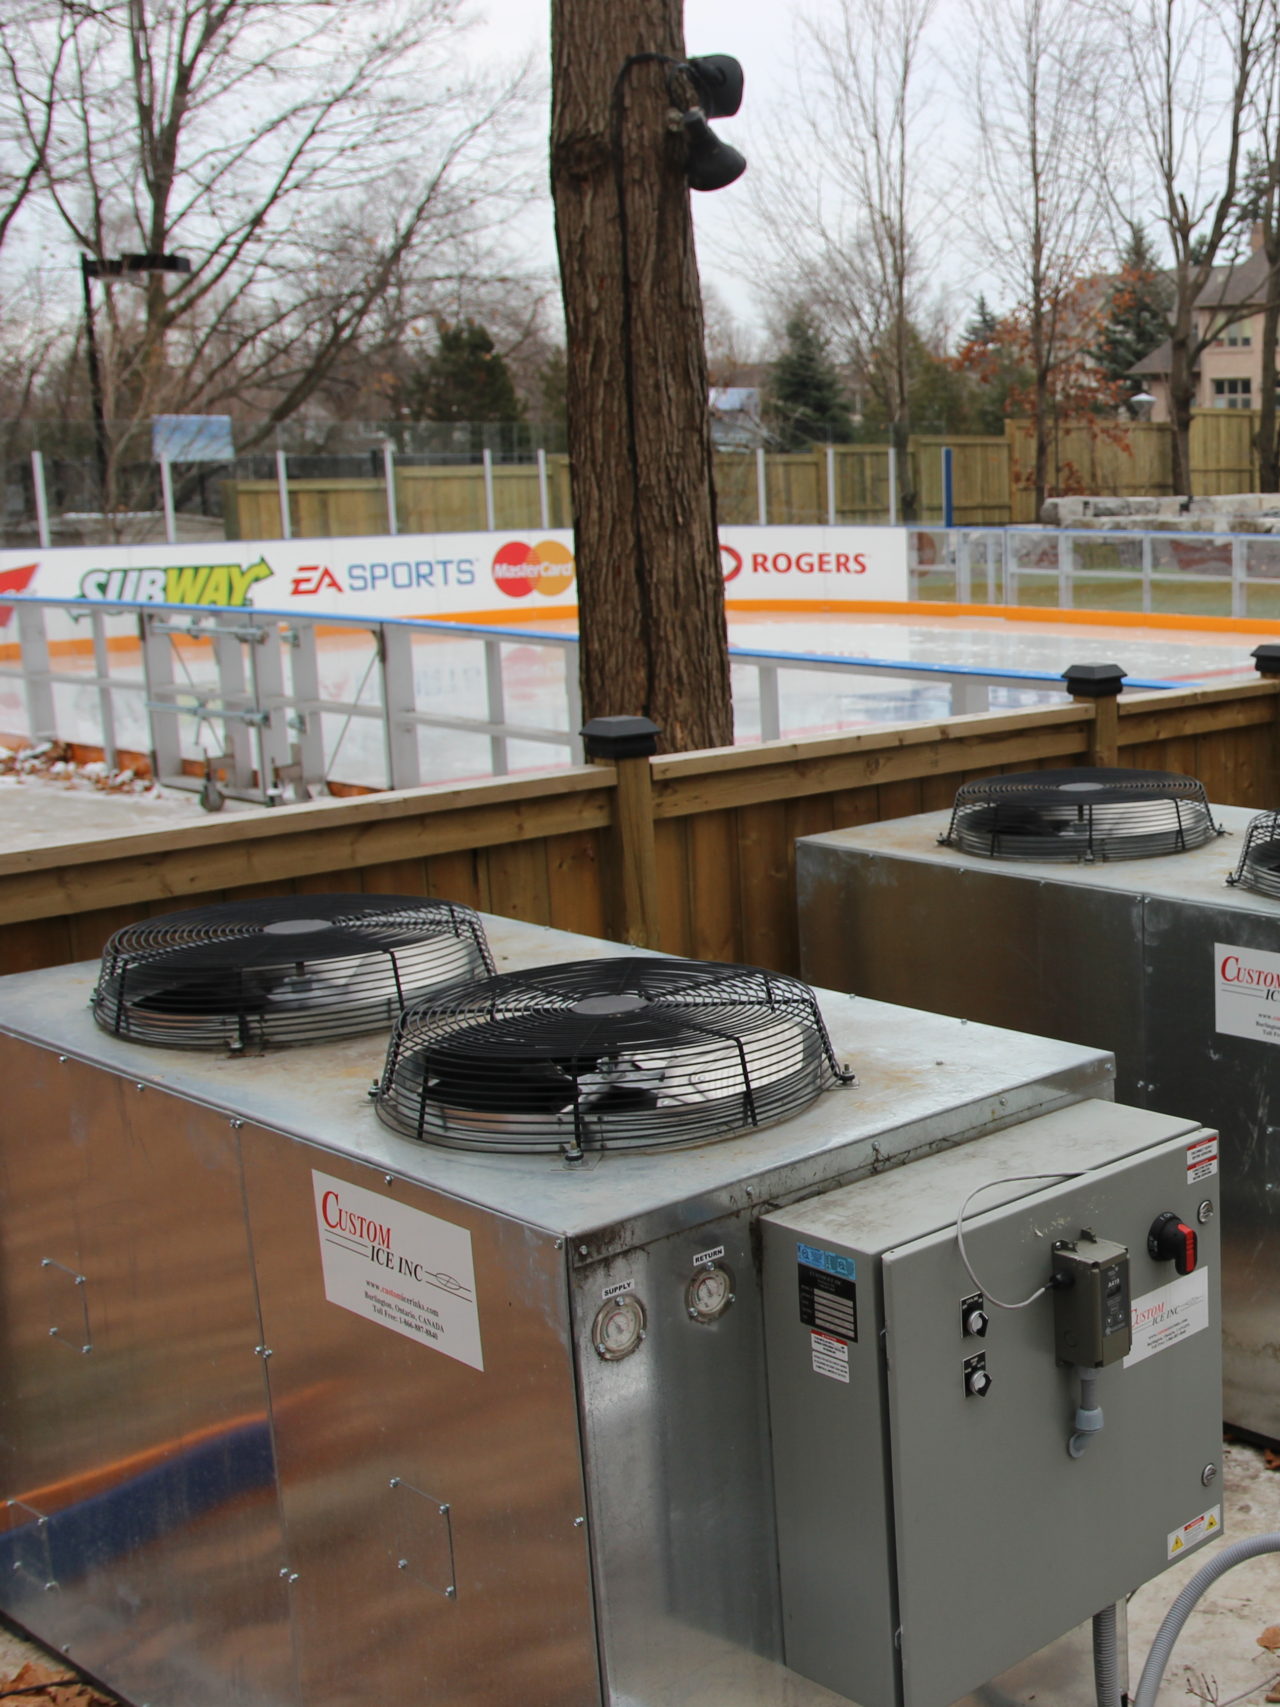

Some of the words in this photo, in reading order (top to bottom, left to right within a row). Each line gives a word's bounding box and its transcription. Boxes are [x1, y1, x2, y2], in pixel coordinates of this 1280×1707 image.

[494, 562, 574, 578] MasterCard
[752, 552, 866, 574] ROGERS
[71, 556, 274, 613] SUBWAY
[290, 565, 344, 596] EA
[348, 558, 475, 592] SPORTS
[322, 1190, 391, 1249] CUSTOM
[370, 1245, 394, 1270] ICE
[399, 1256, 423, 1282] INC
[695, 1248, 723, 1264] RETURN
[604, 1282, 632, 1297] SUPPLY
[364, 1290, 393, 1310] Burlington,
[394, 1304, 417, 1321] Ontario,
[418, 1315, 444, 1333] CANADA
[373, 1304, 383, 1315] Toll
[1130, 1301, 1166, 1328] CUSTOM
[1152, 1314, 1165, 1326] ICE
[1167, 1305, 1180, 1320] INC
